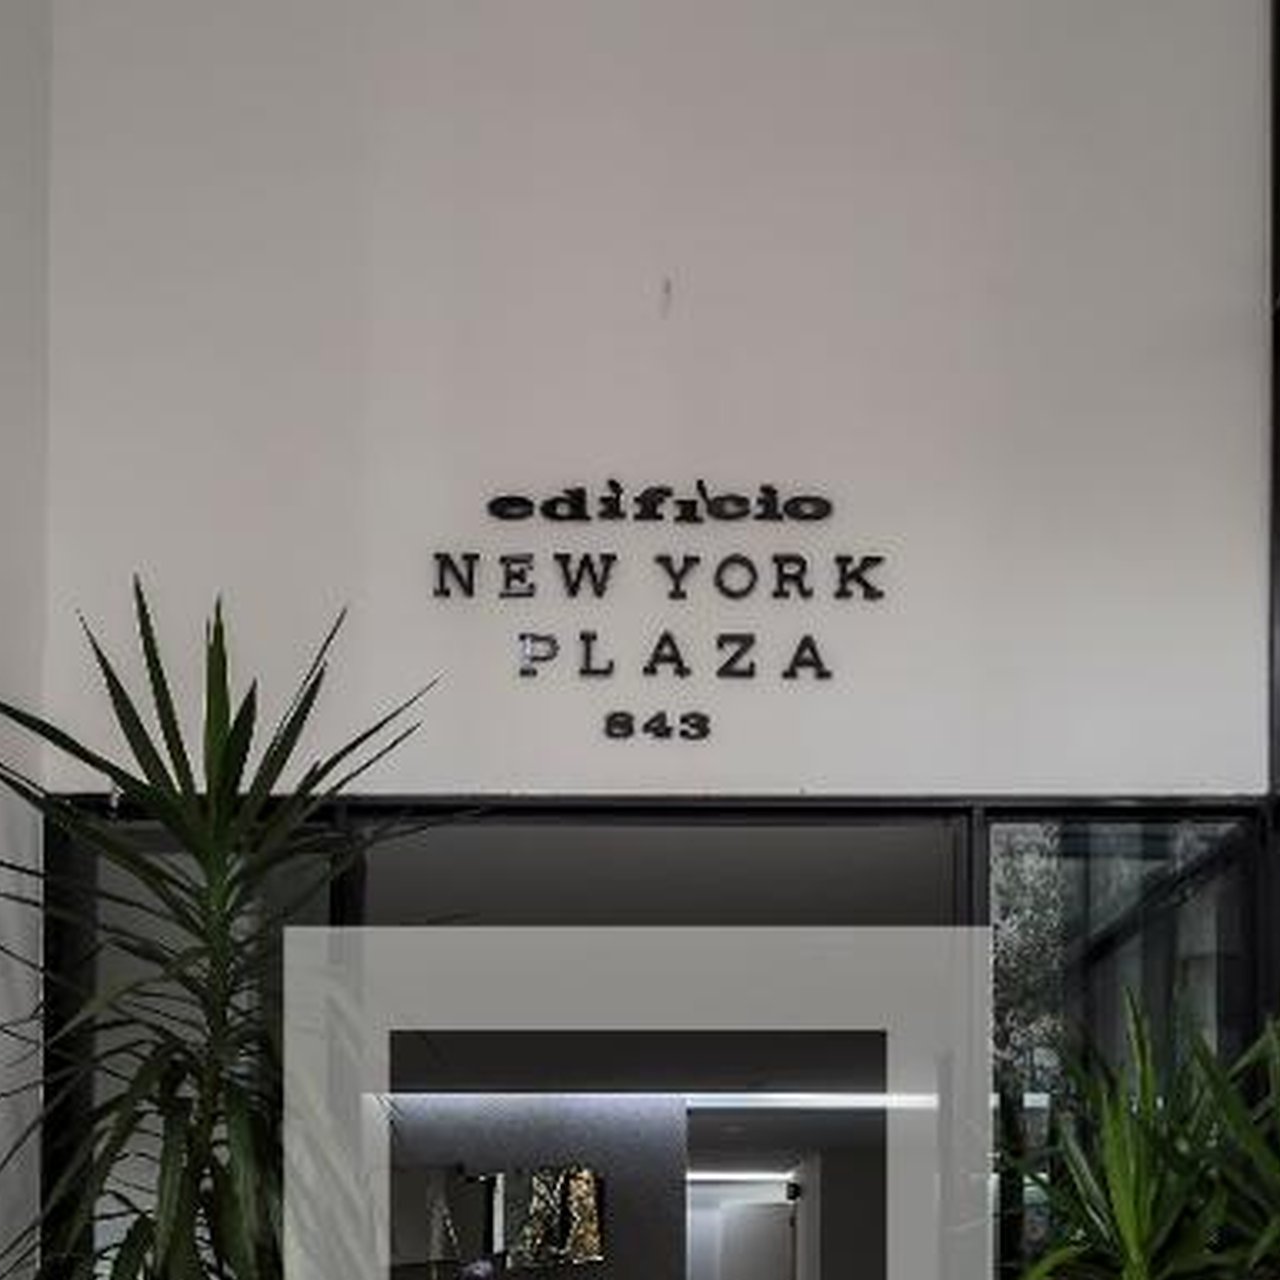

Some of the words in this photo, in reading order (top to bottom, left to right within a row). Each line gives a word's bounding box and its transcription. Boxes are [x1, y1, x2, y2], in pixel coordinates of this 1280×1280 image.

[432, 551, 618, 600] NEW
[653, 552, 886, 602] YORK
[517, 629, 833, 681] PLAZA
[603, 710, 712, 741] 843
